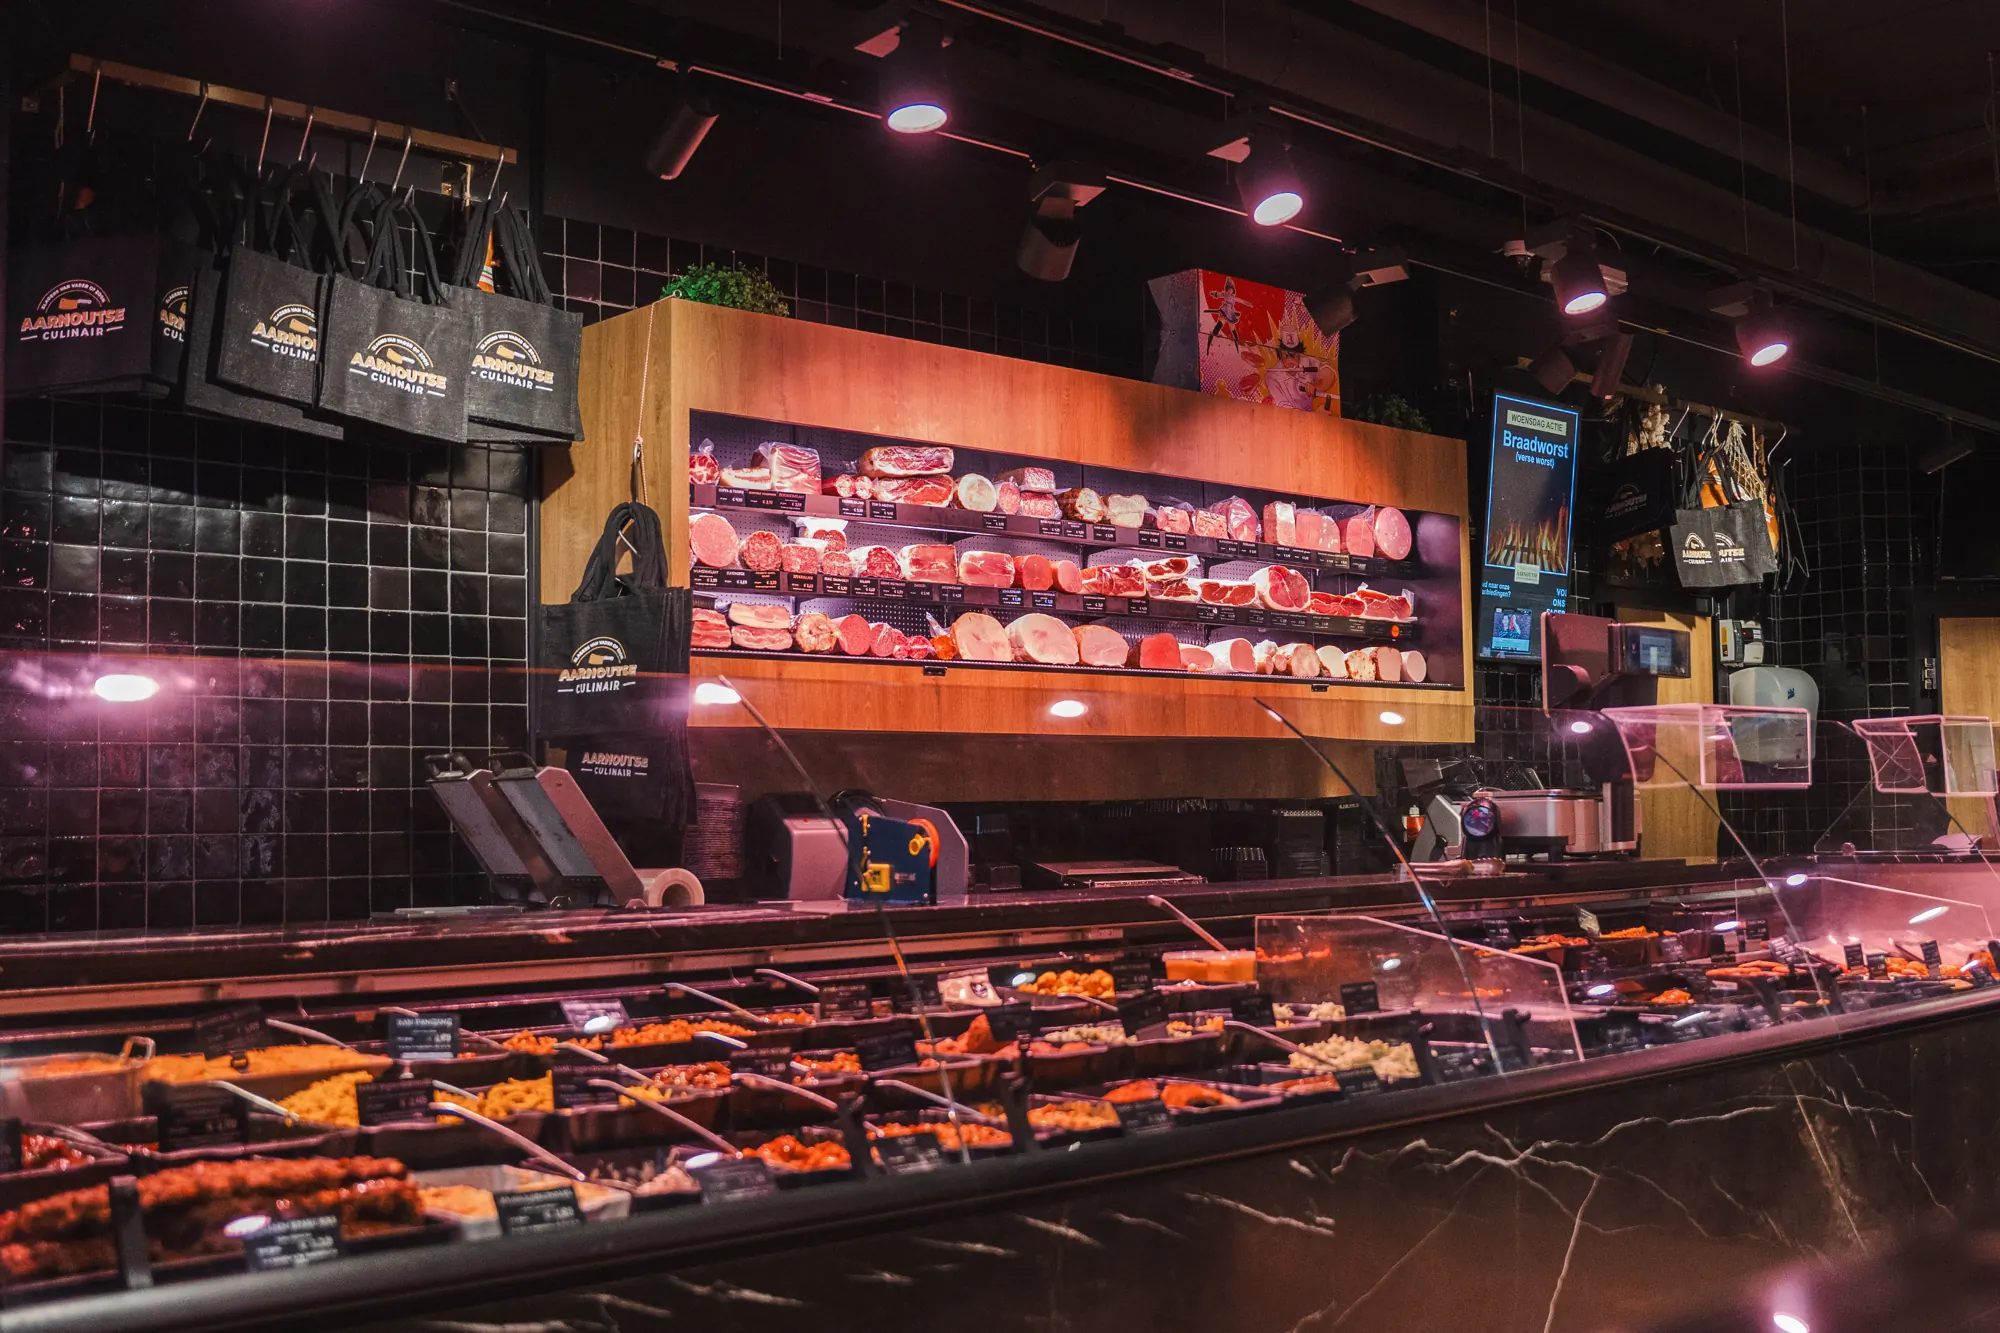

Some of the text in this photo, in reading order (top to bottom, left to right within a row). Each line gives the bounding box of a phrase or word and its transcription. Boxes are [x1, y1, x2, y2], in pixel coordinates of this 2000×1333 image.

[20, 307, 126, 332] AARNOUTSE
[42, 327, 104, 341] CULINAIR
[163, 327, 185, 342] CUL
[349, 351, 447, 390] AARNOUTSE
[370, 372, 424, 395] CULINAIR
[479, 370, 534, 390] CULINAIR
[1511, 413, 1563, 432] WOENSDAG ACTIE
[1503, 429, 1569, 459] Braadworst
[1515, 451, 1555, 469] (verse worst)
[1488, 581, 1499, 589] naar
[1552, 598, 1566, 608] ONS
[558, 664, 638, 682] AARNOUTSE
[575, 680, 620, 694] CULINAIR
[581, 751, 649, 769] AARNOUTSE
[594, 766, 632, 777] CULINAIR
